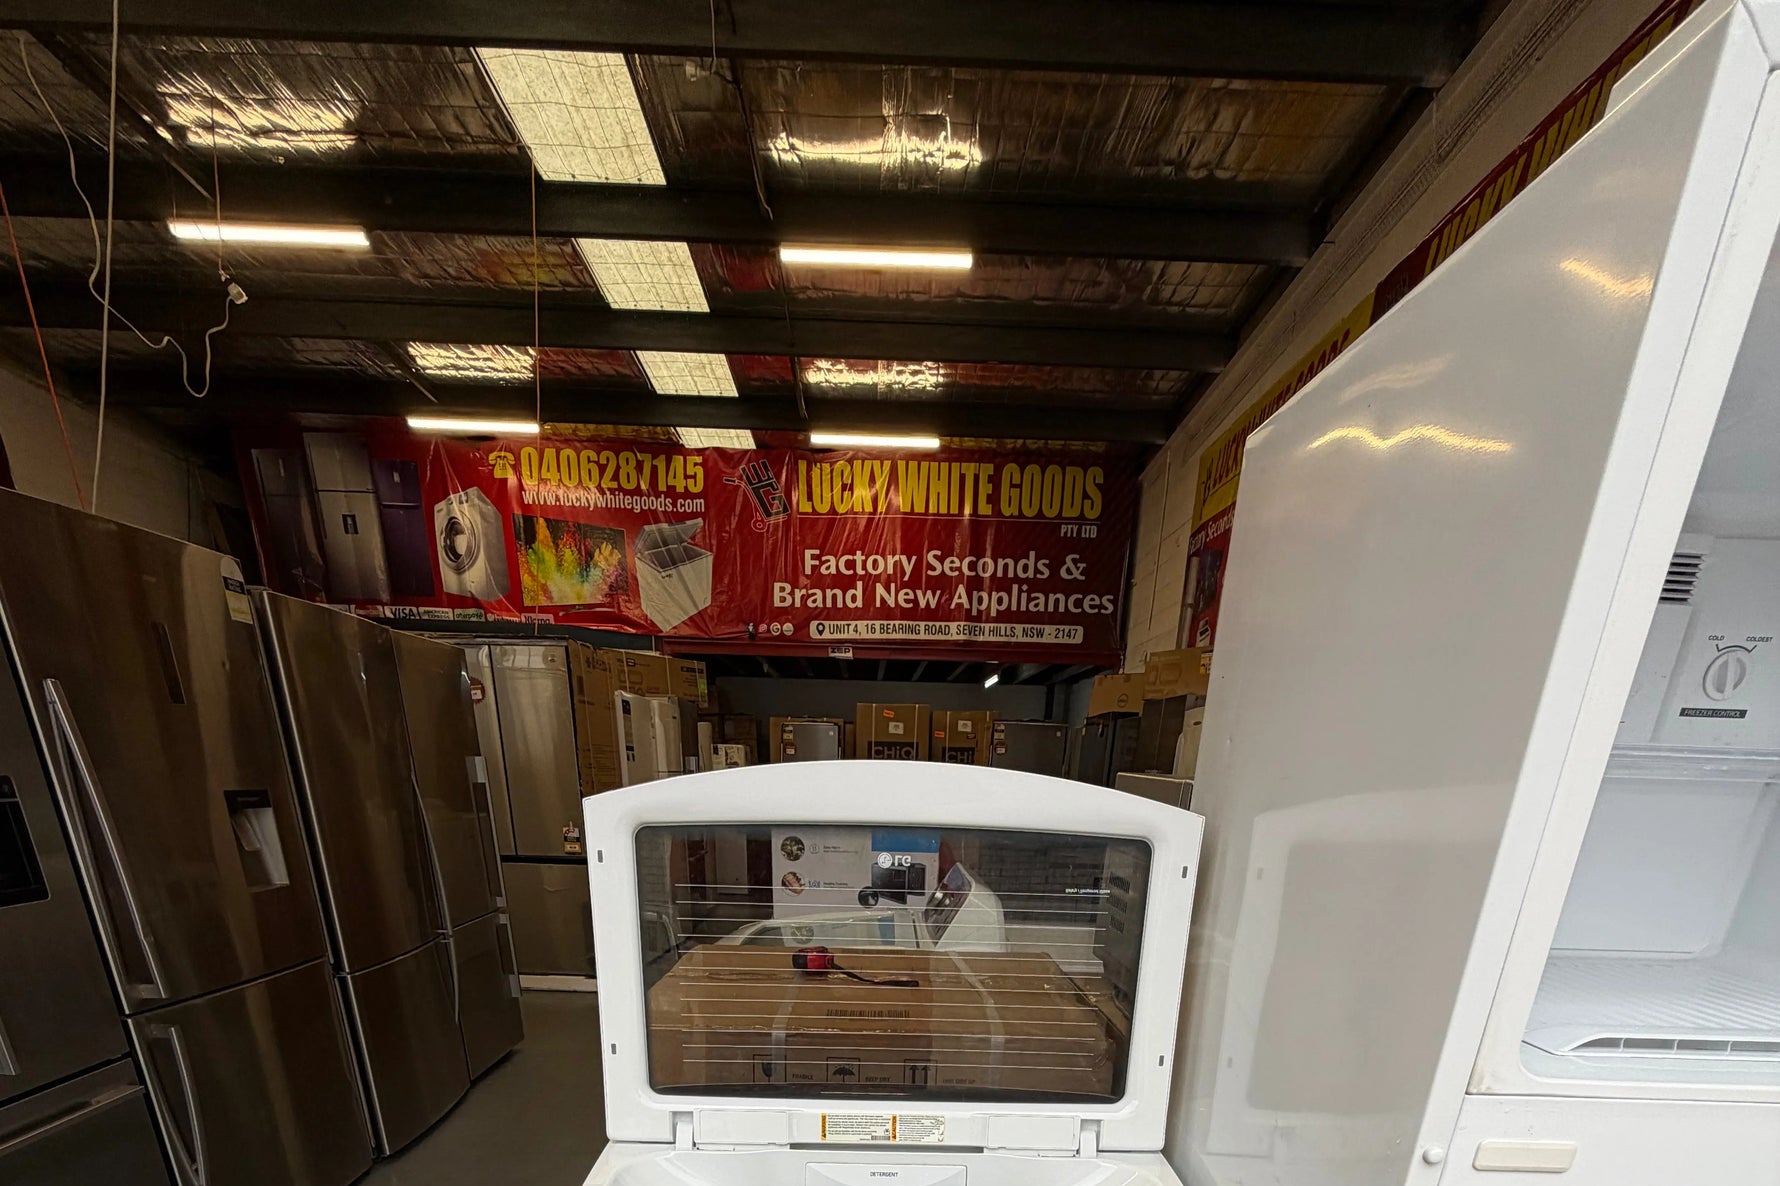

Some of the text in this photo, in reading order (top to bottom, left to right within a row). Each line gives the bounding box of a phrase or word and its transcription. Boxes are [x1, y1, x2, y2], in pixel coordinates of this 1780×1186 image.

[521, 446, 704, 493] 0406287145
[522, 491, 704, 512] www.luckywhitegoods.com
[798, 460, 891, 513] LUCKY
[898, 460, 994, 515] WHITE
[1001, 463, 1103, 519] GOODS
[1061, 524, 1097, 538] PTY LTD
[804, 550, 1086, 581] Factory Seconds &
[774, 581, 1114, 616] Brand New Appliances
[391, 608, 416, 620] VISA
[828, 623, 850, 634] UNIT
[852, 624, 861, 636] 4,
[865, 624, 876, 634] 16
[879, 624, 920, 635] BEARING
[924, 624, 953, 637] ROAD,
[956, 625, 985, 636] SEVEN
[988, 626, 1018, 639] HILLS,
[1022, 627, 1045, 638] NSW
[1055, 628, 1078, 639] 2147
